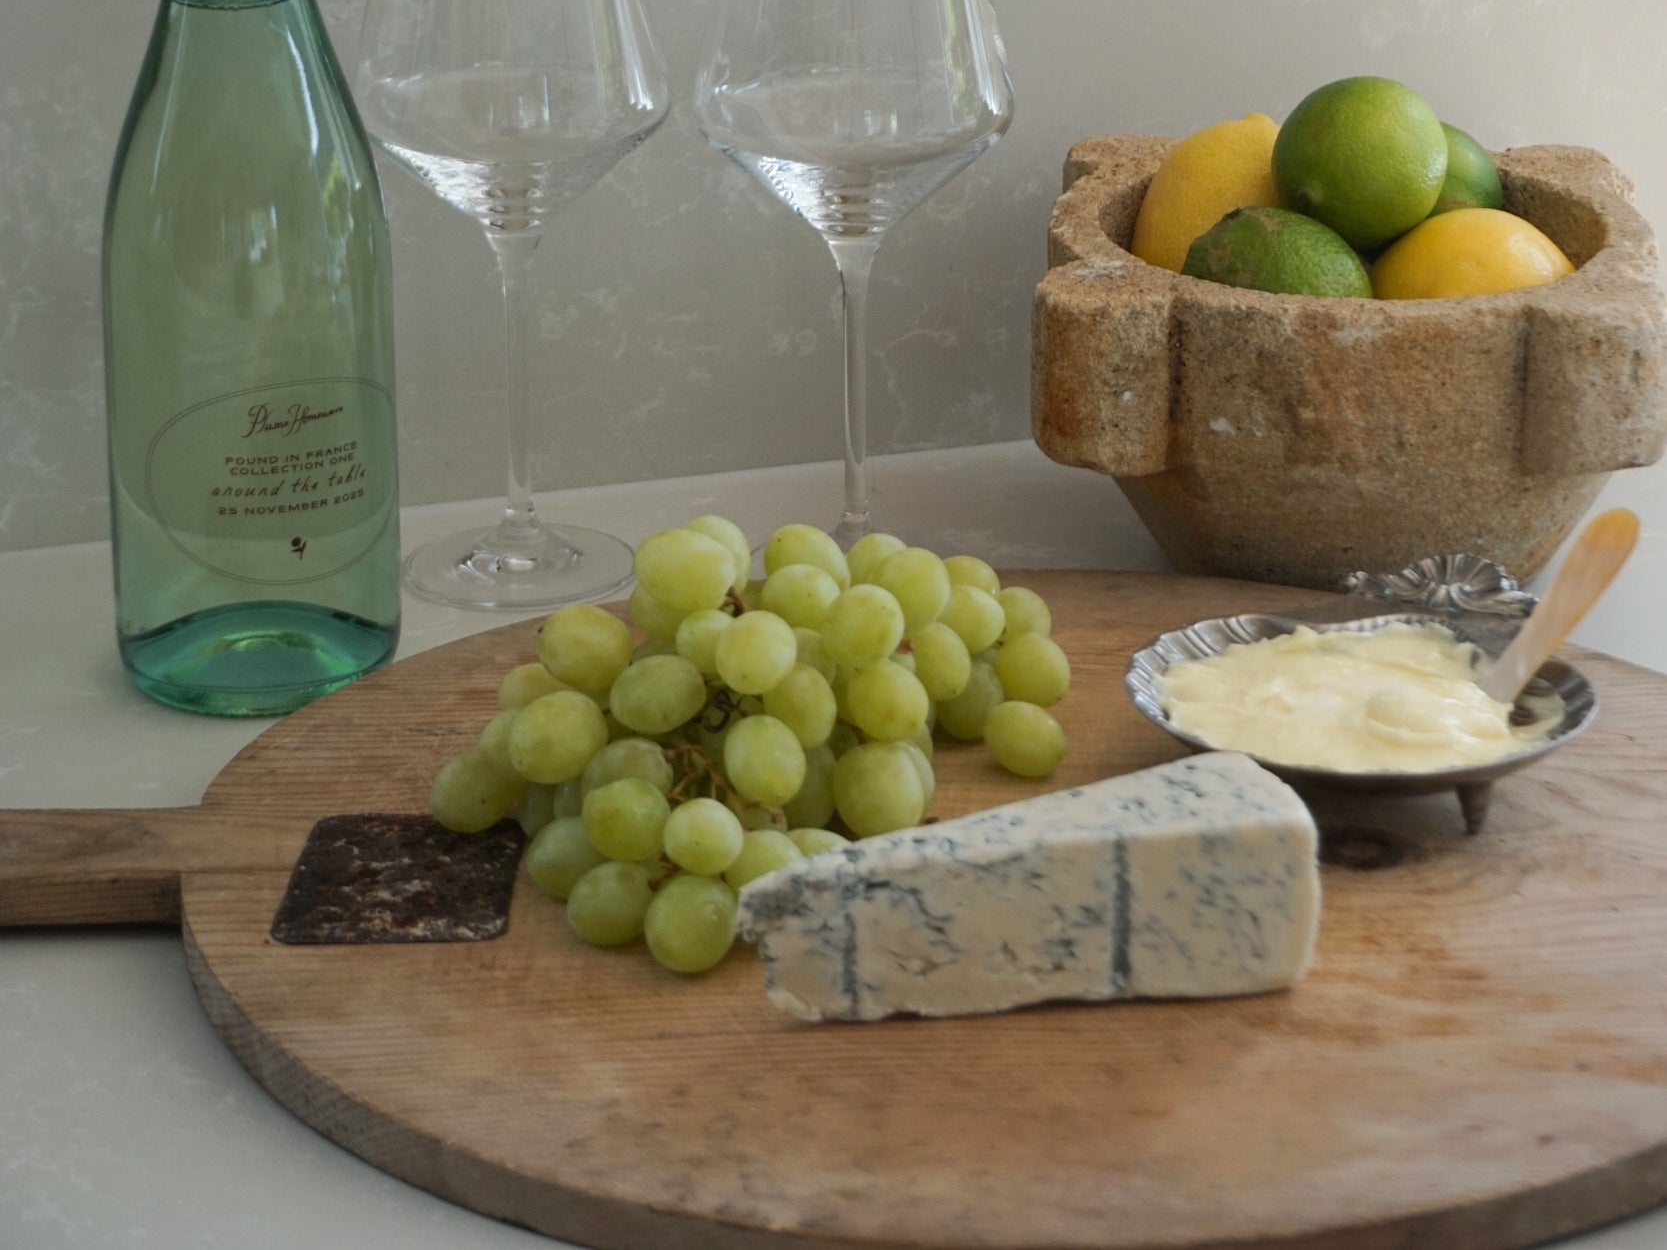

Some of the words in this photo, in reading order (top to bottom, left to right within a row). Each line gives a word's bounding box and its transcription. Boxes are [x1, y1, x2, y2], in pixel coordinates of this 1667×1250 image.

[225, 455, 279, 465] FOUND
[285, 454, 300, 462] IN
[306, 440, 358, 458] FRANCE
[230, 460, 324, 475] COLLECTION
[329, 452, 355, 465] ONE
[212, 479, 285, 497] around
[291, 475, 319, 493] the
[328, 463, 367, 487] table
[218, 506, 238, 516] 25
[244, 498, 328, 515] NOVEMBER
